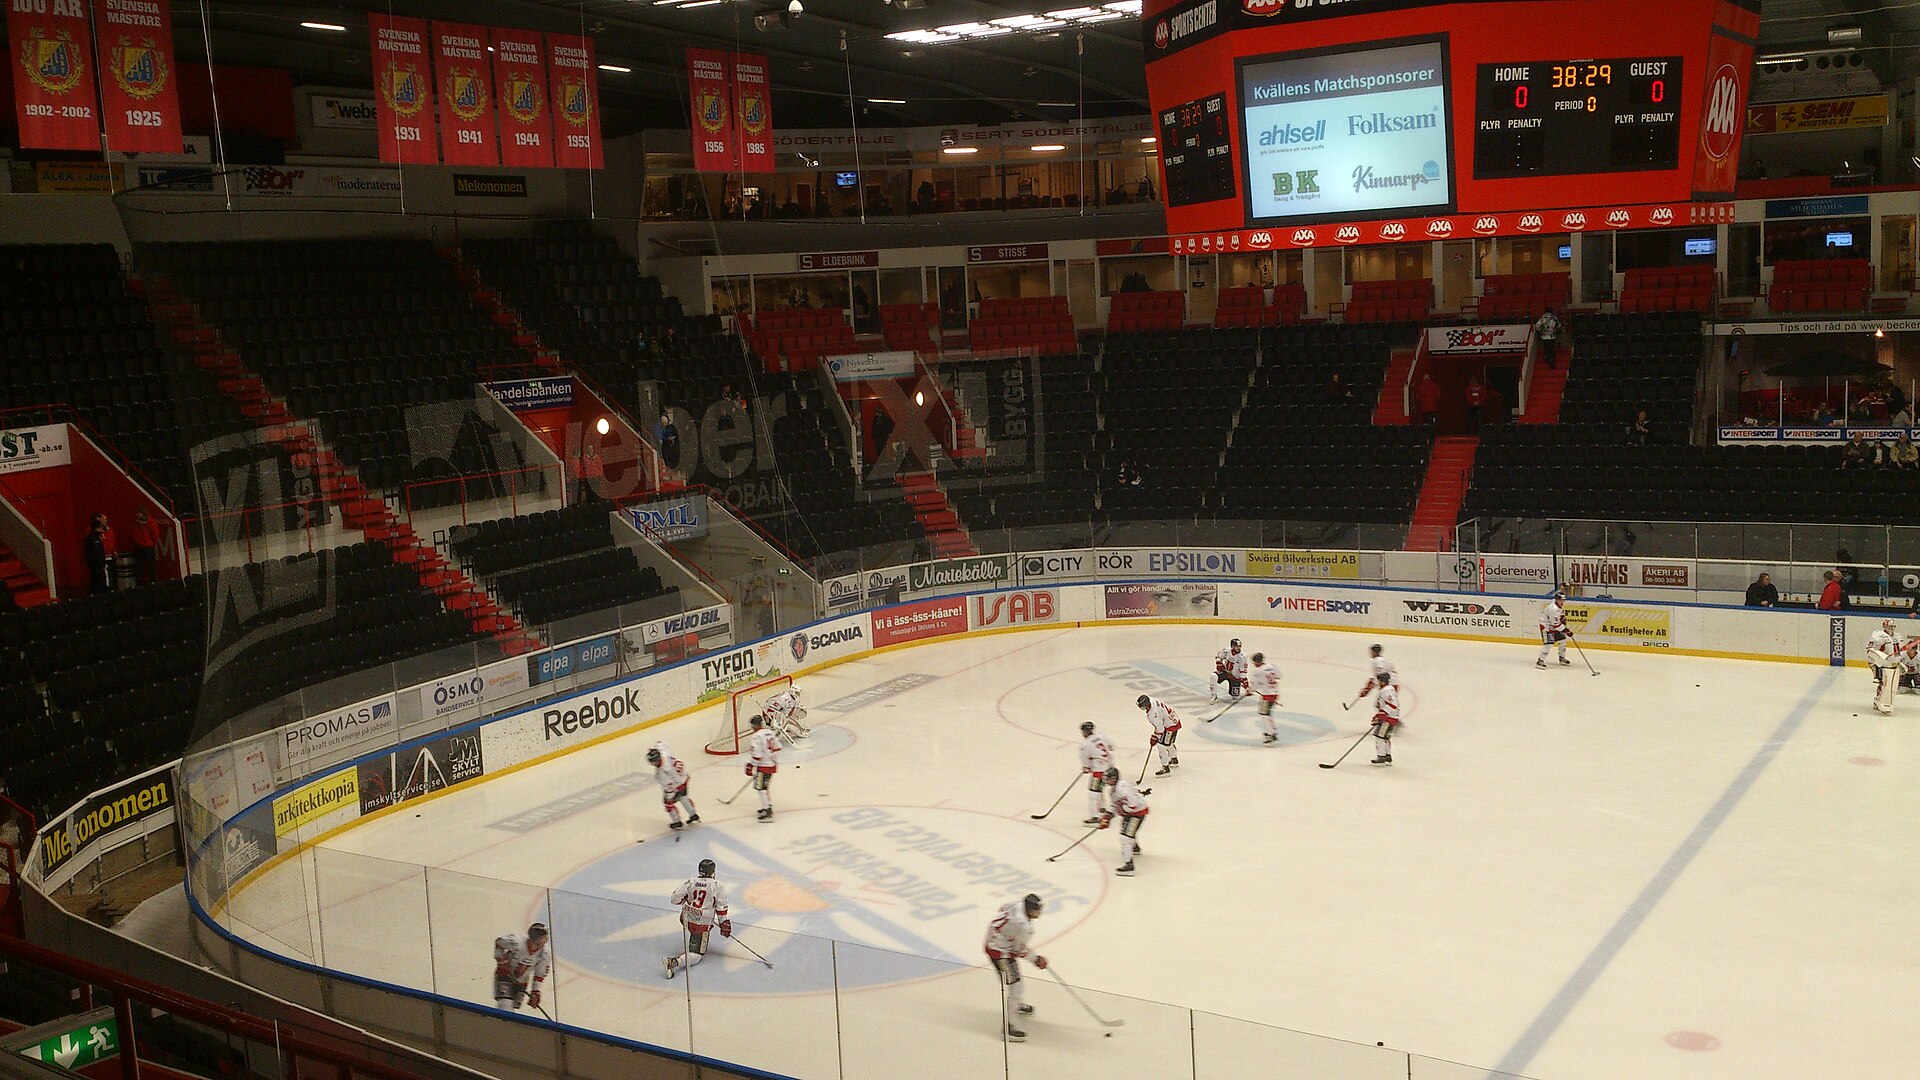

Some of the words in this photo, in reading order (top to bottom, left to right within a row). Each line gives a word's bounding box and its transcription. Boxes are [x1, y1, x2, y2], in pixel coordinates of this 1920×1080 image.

[106, 0, 160, 14] SVENSKA
[107, 11, 162, 27] MÄSTARE
[1156, 21, 1169, 42] AXA
[1170, 8, 1194, 41] SPORTS
[1193, 0, 1217, 32] CENTER
[378, 27, 420, 42] SVENSKA
[441, 34, 481, 49] SVENSKA
[379, 38, 421, 54] MÄSTARE
[442, 46, 482, 60] MÄSTARE
[500, 40, 537, 54] SVENSKA
[554, 45, 588, 58] SVENSKA
[501, 52, 539, 65] MÄSTARE
[555, 56, 590, 69] MÄSTARE
[693, 60, 722, 71] SVENSKA
[693, 69, 723, 81] MÄSTARE
[736, 63, 764, 75] SVENSKA
[1495, 67, 1530, 82] HOME
[1552, 64, 1612, 88] 38:29
[1630, 62, 1668, 76] GUEST
[737, 73, 765, 84] MÄSTARE
[1253, 82, 1311, 100] Kvällens
[1314, 67, 1435, 93] Matchsponsorer
[1515, 85, 1528, 108] 0
[1651, 79, 1664, 103] 0
[25, 104, 92, 118] 1902-2002
[1555, 100, 1583, 111] PERIOD
[1587, 96, 1597, 112] 0
[1706, 75, 1736, 135] AXA
[1801, 101, 1855, 119] SEMI
[125, 109, 162, 127] 1925
[338, 103, 377, 121] webe
[1614, 114, 1634, 124] PLYR
[1641, 112, 1675, 124] PENALTY
[1347, 113, 1438, 137] Folksam
[1480, 120, 1501, 130] PLYR
[1507, 118, 1543, 129] PENALTY
[394, 126, 421, 141] 1931
[457, 129, 483, 144] 1941
[515, 132, 540, 146] 1944
[1258, 119, 1327, 147] ahlsell
[567, 134, 590, 148] 1953
[704, 140, 724, 153] 1956
[746, 141, 765, 154] 1985
[457, 179, 523, 193] Mekonomen
[1352, 165, 1433, 193] Kinnarps
[1564, 214, 1586, 225] AXA
[1608, 211, 1629, 222] AXA
[1653, 208, 1673, 219] AXA
[1428, 221, 1451, 233] AXA
[1475, 217, 1497, 229] AXA
[1519, 216, 1542, 227] AXA
[1294, 229, 1315, 241] AXA
[1338, 226, 1360, 238] AXA
[1382, 223, 1405, 235] AXA
[1250, 232, 1272, 244] AXA
[998, 247, 1027, 258] STISSE
[823, 254, 866, 266] ELDEBRINK
[1779, 323, 1799, 333] Tips
[1803, 322, 1821, 332] och
[1824, 321, 1841, 331] råd
[1730, 430, 1776, 438] INTERSPORT
[1792, 430, 1838, 438] INTERSPORT
[1860, 430, 1901, 438] NTERSPORT
[1046, 556, 1082, 572] CITY
[1099, 552, 1133, 569] RÖR
[1149, 553, 1235, 573] EPSILON
[1248, 552, 1280, 563] Swärd
[1283, 554, 1338, 564] Bilverkstad
[1340, 555, 1357, 564] AB
[914, 561, 1003, 589] Mariekälla
[1485, 564, 1549, 580] öderenergi
[1673, 569, 1685, 577] AB
[1107, 586, 1119, 594] Allt
[1128, 586, 1140, 594] gör
[977, 590, 1055, 626] ISAB
[1107, 607, 1149, 616] AstraZeneca
[1284, 597, 1371, 615] INTERSPORT
[1403, 600, 1510, 616] WEDA
[700, 608, 720, 626] BIL
[875, 618, 884, 630] Vi
[1403, 614, 1470, 627] INSTALLATION
[1471, 617, 1511, 628] SERVICE
[1610, 625, 1654, 636] Fastigheter
[1656, 628, 1667, 636] AB
[810, 626, 863, 651] SCANIA
[1832, 619, 1843, 659] Reebok
[542, 654, 569, 674] elpa
[581, 643, 610, 663] elpa
[702, 648, 754, 681] TYFON
[433, 676, 484, 706] ÖSMO
[436, 698, 475, 716] BANDSERVICE
[543, 687, 641, 741] Reebok
[285, 708, 371, 748] PROMAS
[311, 741, 328, 751] kraft
[328, 737, 340, 745] och
[340, 730, 361, 742] energi
[452, 757, 480, 773] SKYLT
[452, 766, 480, 781] service
[277, 778, 355, 826] arkitektkopia
